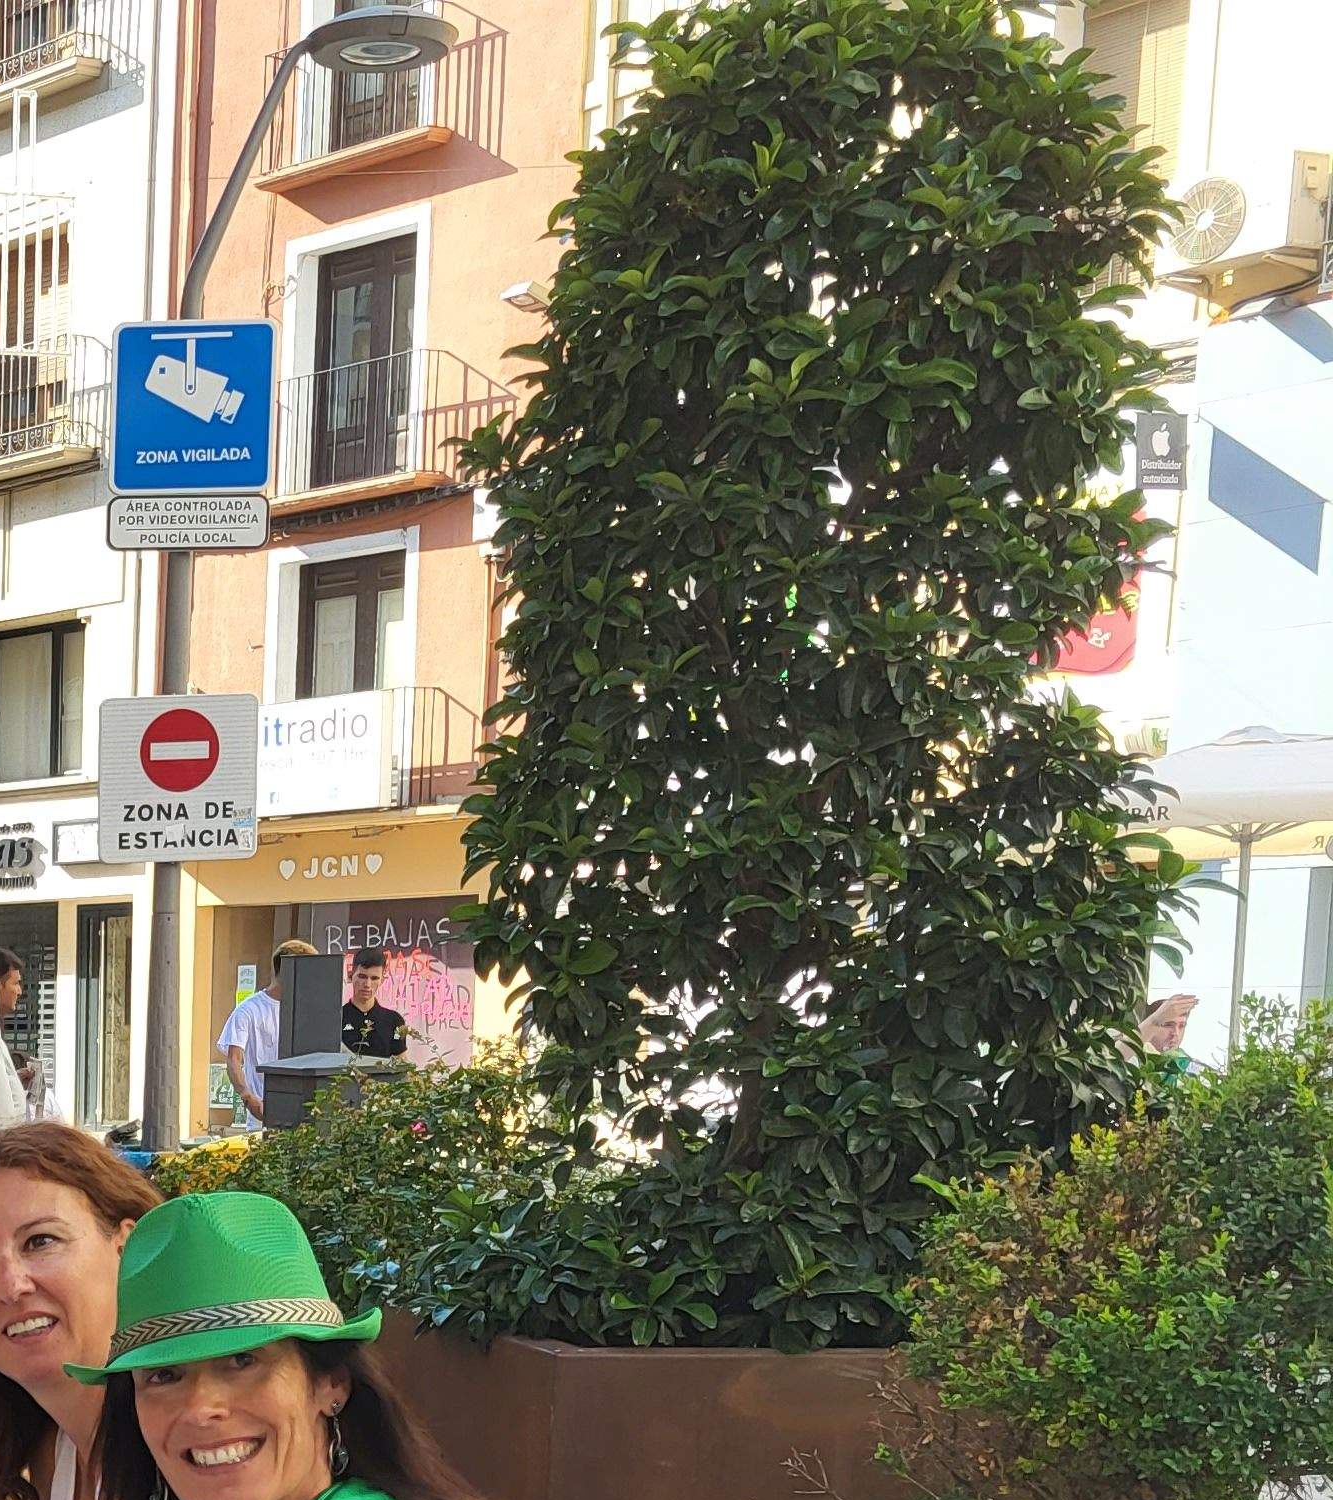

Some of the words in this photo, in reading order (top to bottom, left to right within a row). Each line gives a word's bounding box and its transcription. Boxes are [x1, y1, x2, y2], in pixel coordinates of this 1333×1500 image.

[135, 450, 179, 465] ZONA
[181, 446, 252, 463] VIGILADA
[1141, 459, 1183, 471] Distribuidor
[1142, 473, 1180, 485] autorizado
[126, 499, 161, 513] ÁREA
[164, 500, 252, 513] CONTROLADA
[118, 514, 145, 526] POR
[148, 513, 260, 525] VIDEOVIGILANCIA
[139, 531, 191, 545] POLICÍA
[194, 533, 237, 544] LOCAL
[122, 802, 190, 823] ZONA
[204, 800, 235, 820] DE
[303, 854, 359, 879] JCN
[326, 917, 451, 956] REBAJAS
